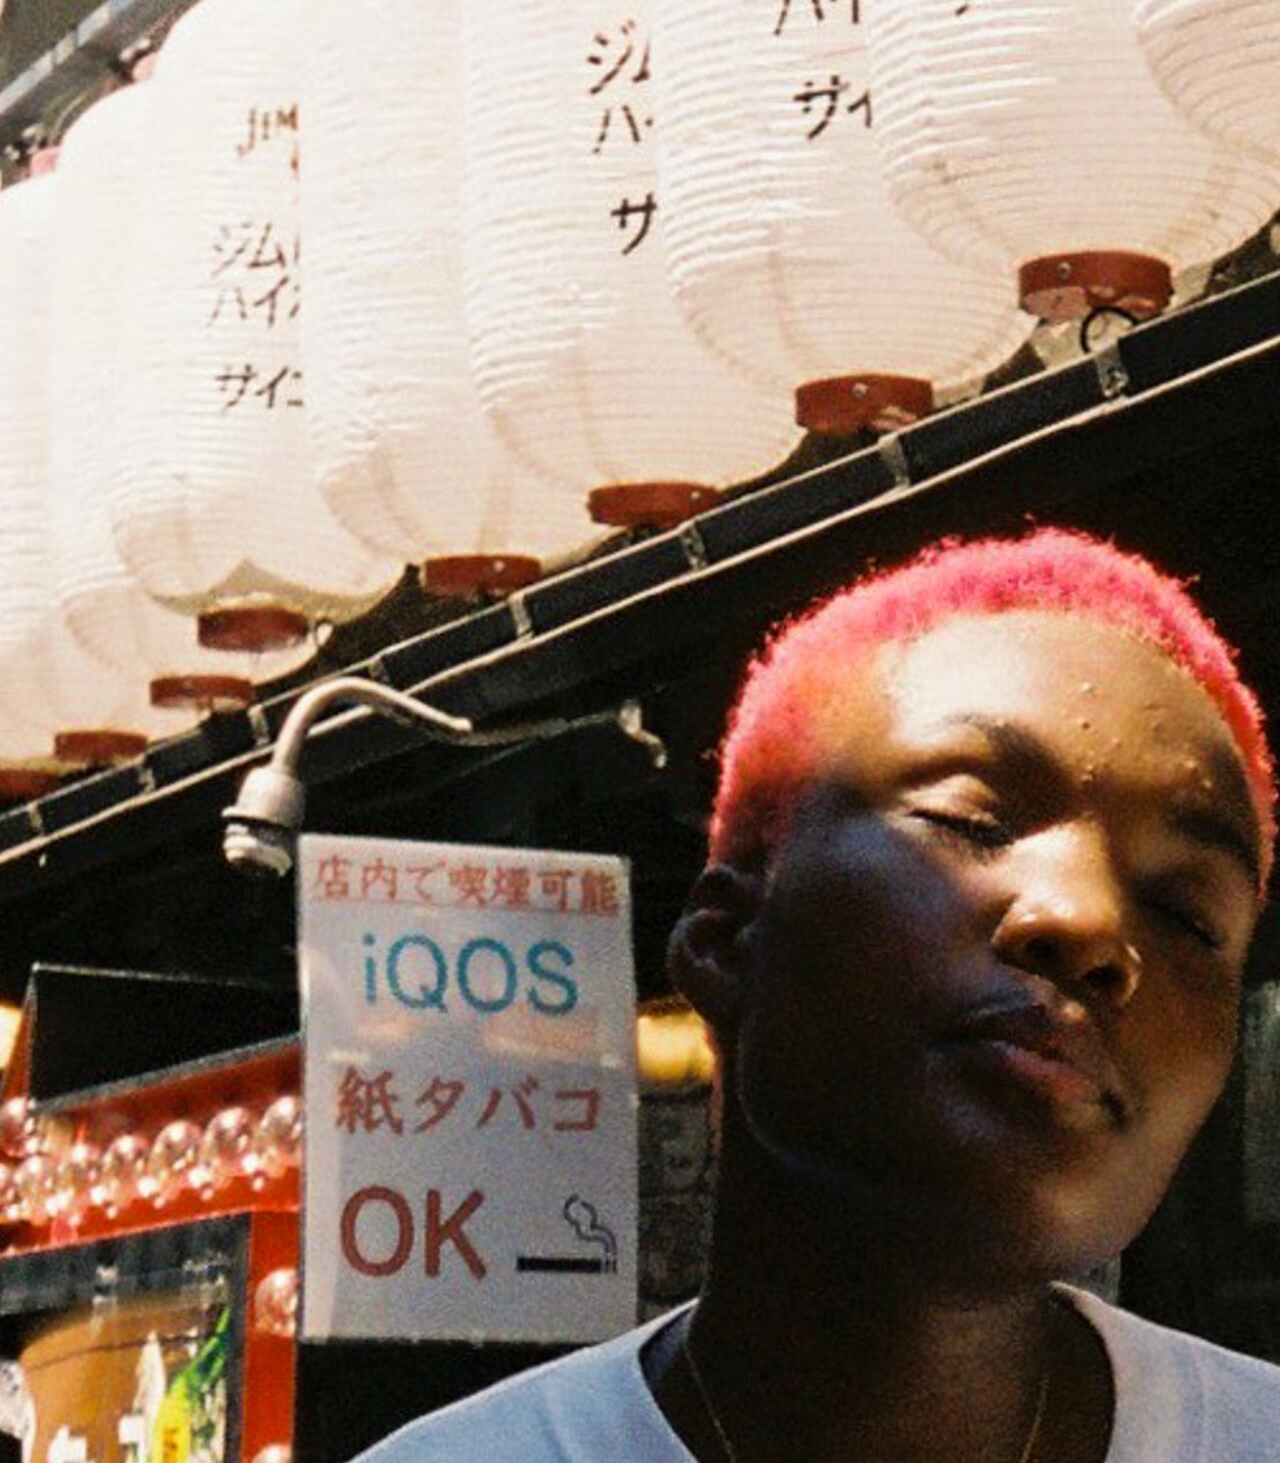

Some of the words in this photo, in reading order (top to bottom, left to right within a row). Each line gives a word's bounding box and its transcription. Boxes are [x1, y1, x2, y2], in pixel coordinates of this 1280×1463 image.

[610, 192, 658, 255] サ
[316, 854, 620, 916] 店内で喫煙可能
[361, 932, 580, 1016] iQOS
[335, 1065, 602, 1136] 紙タバコ
[339, 1184, 488, 1281] OK
